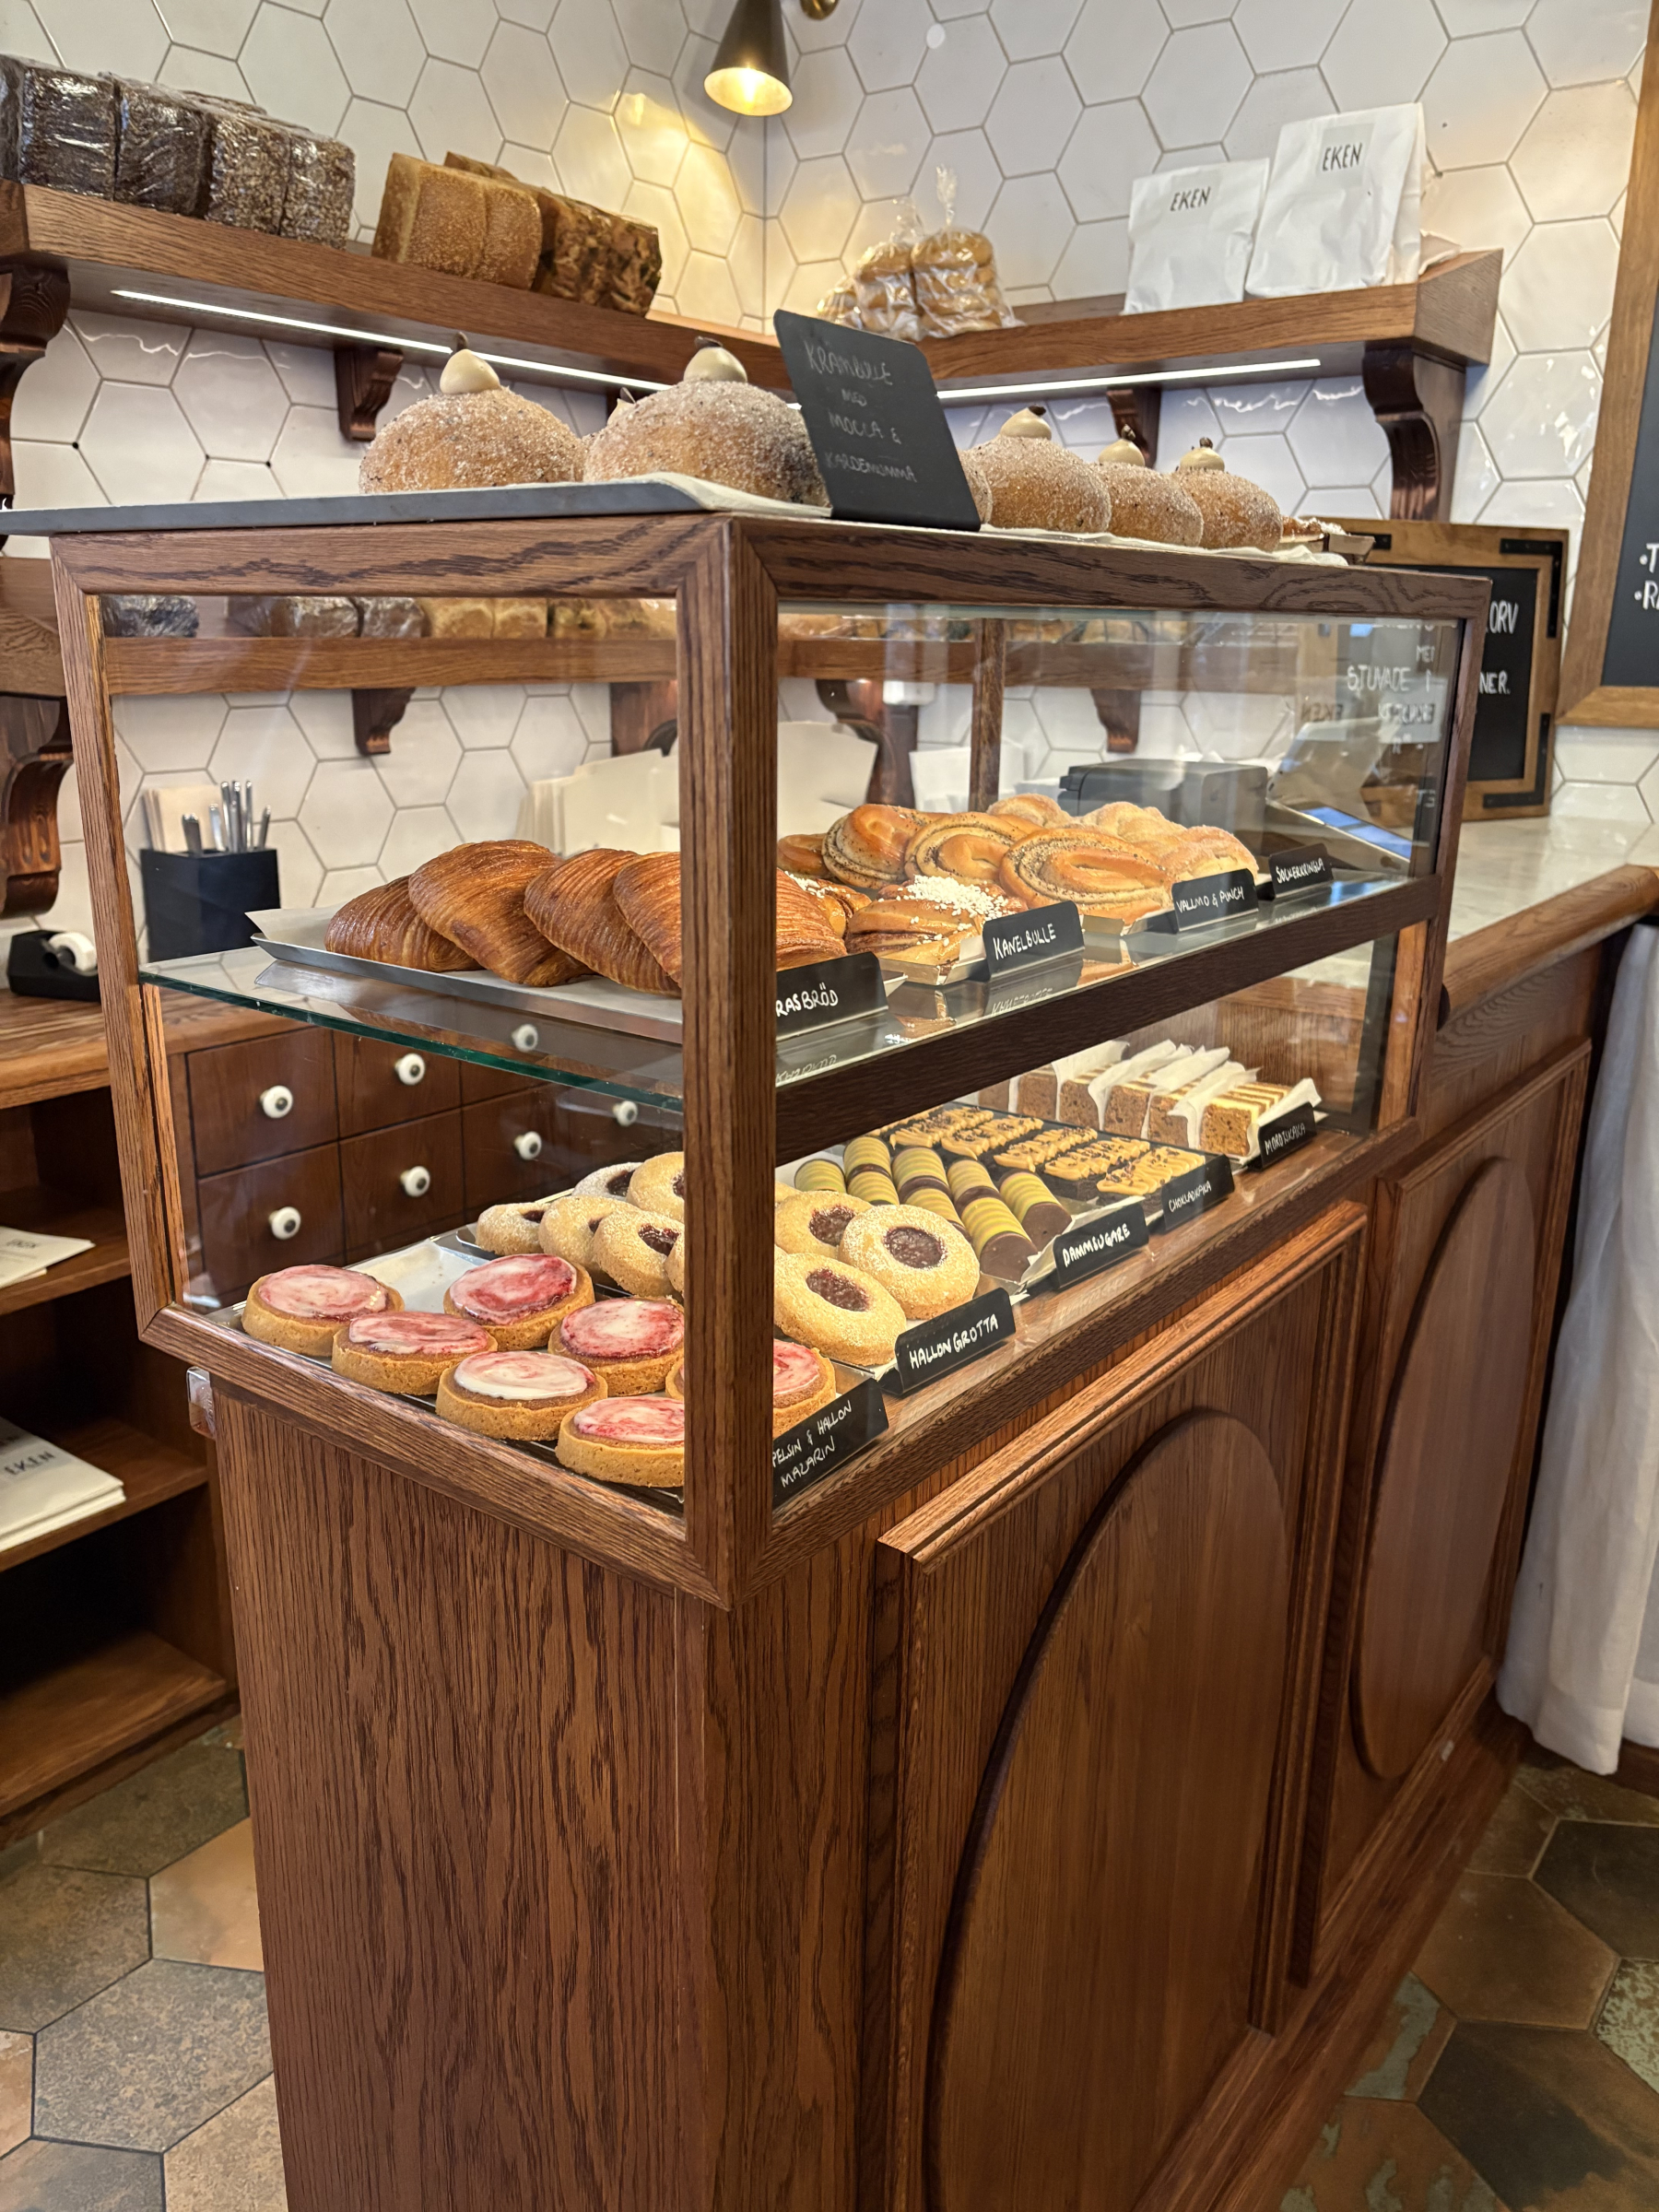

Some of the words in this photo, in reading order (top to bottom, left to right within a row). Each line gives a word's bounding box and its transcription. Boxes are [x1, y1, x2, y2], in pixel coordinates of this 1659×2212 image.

[1322, 143, 1362, 171] EKEN
[1170, 186, 1211, 211] EKEN
[841, 388, 867, 406] MED
[1486, 599, 1520, 634] ORV
[1176, 895, 1210, 913] VALLMO
[1212, 892, 1219, 908] &
[1219, 885, 1245, 903] PUNCH
[993, 924, 1056, 960] KANELBULLE
[775, 981, 840, 1018] RASBRÖD
[1168, 1180, 1212, 1213] CHOKLADKAKA
[1062, 1222, 1131, 1268] DAMMSUGARE
[806, 1429, 814, 1445] &
[817, 1400, 853, 1435] HALLON
[780, 1435, 836, 1488] MAZARIN
